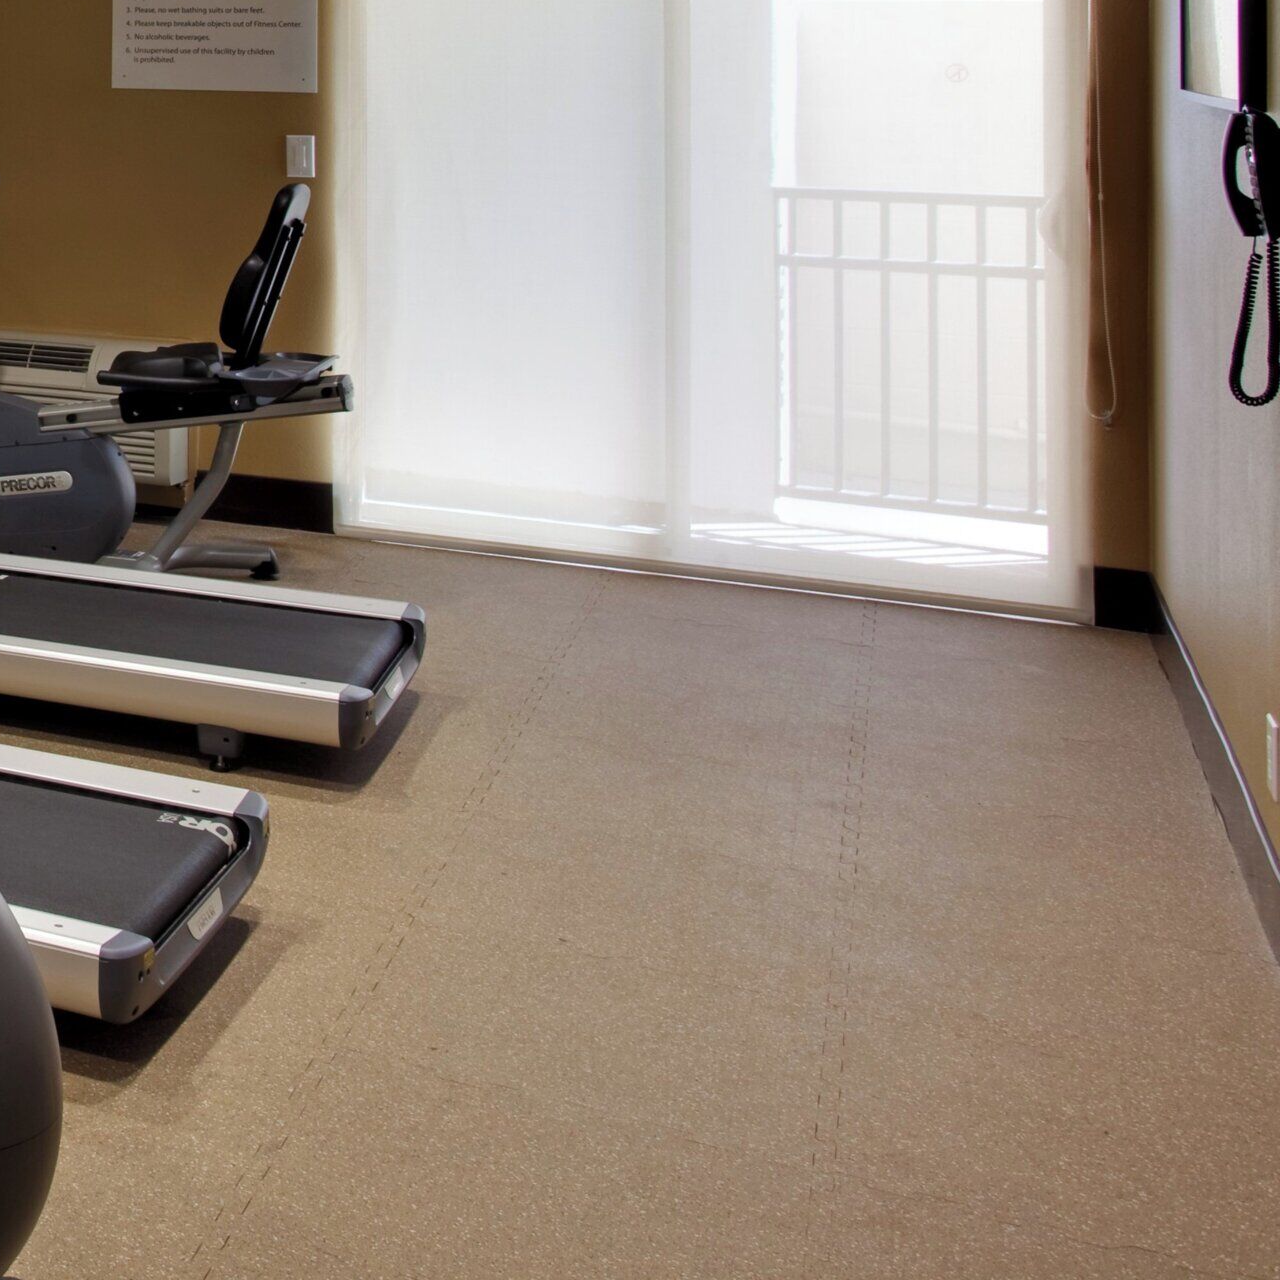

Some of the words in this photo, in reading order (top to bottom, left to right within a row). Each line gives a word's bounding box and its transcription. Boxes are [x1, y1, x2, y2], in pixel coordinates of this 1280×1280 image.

[181, 7, 207, 15] bathing
[156, 20, 172, 29] keep
[207, 20, 231, 29] objects
[134, 48, 178, 56] Unsupervised
[214, 48, 236, 56] facility
[237, 48, 245, 56] by
[0, 476, 57, 493] PRECOR
